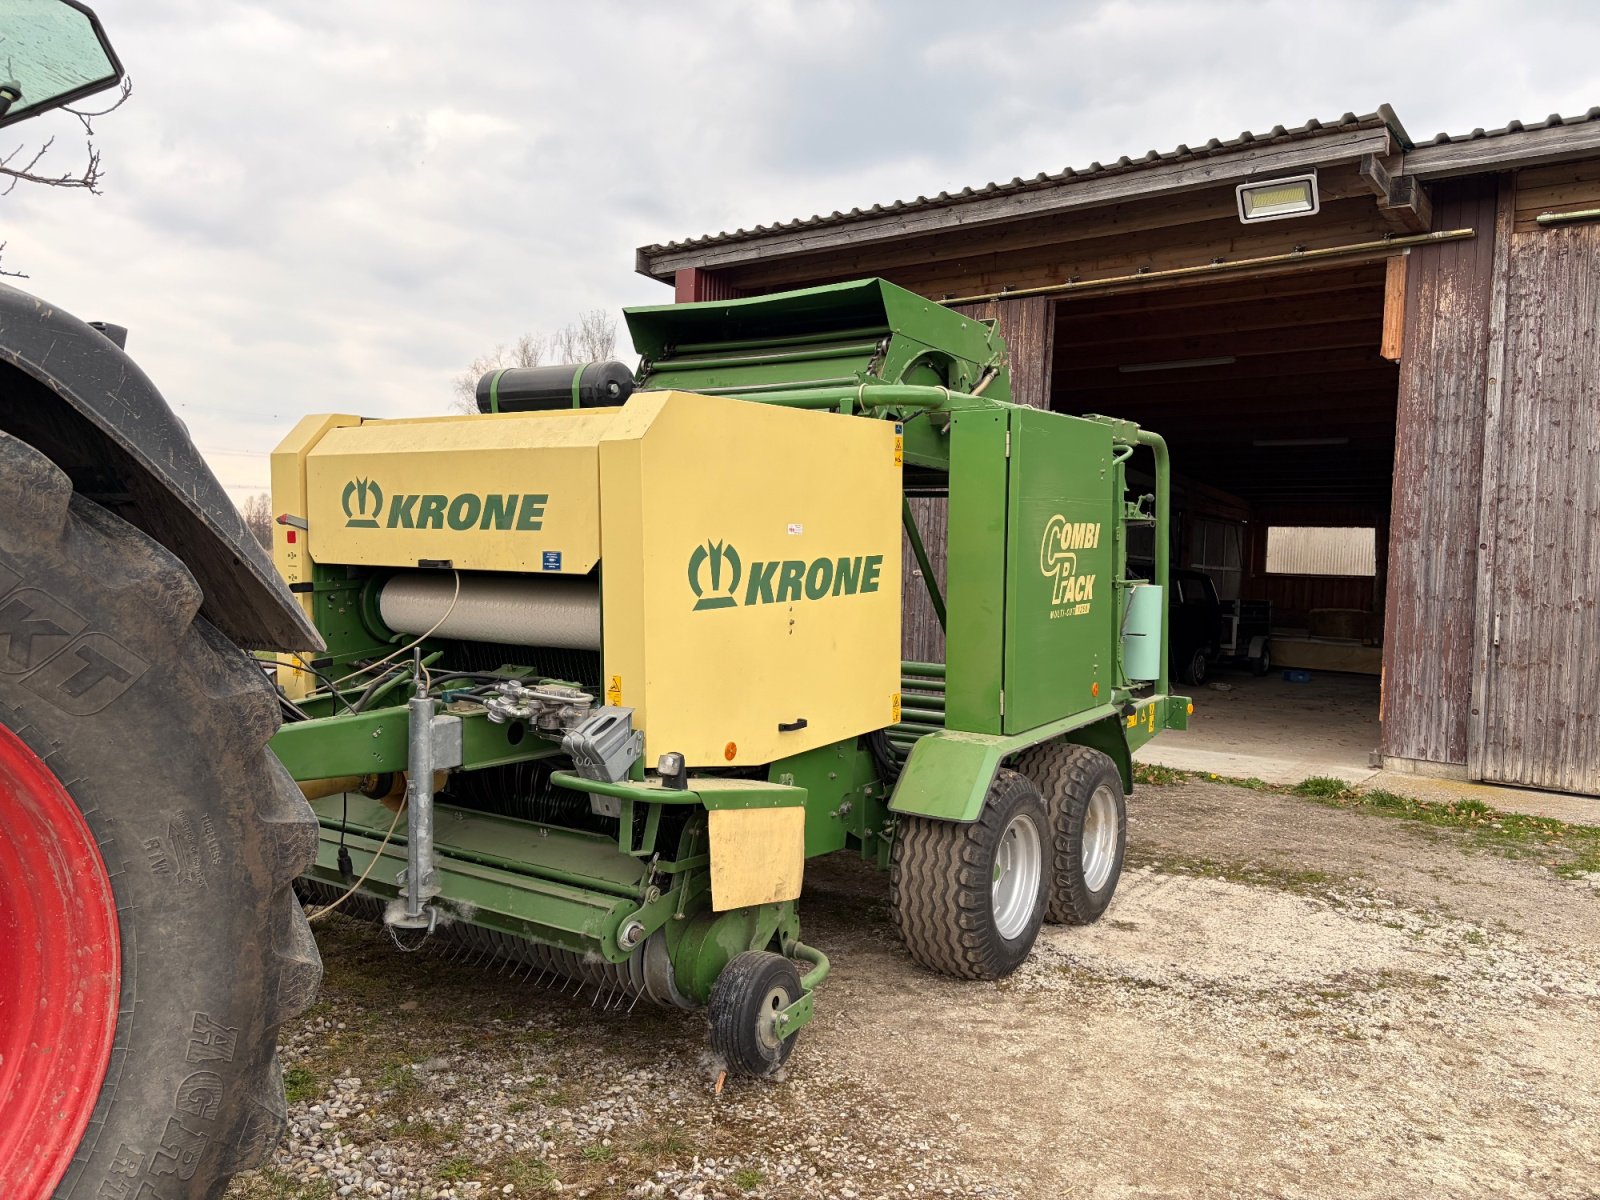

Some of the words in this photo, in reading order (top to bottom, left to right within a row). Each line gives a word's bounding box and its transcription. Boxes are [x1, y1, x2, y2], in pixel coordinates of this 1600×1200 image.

[386, 493, 549, 531] KRONE
[1041, 514, 1100, 576] COMBI
[744, 554, 884, 606] KRONE
[1052, 552, 1096, 605] PACK
[134, 1012, 239, 1200] AGR
